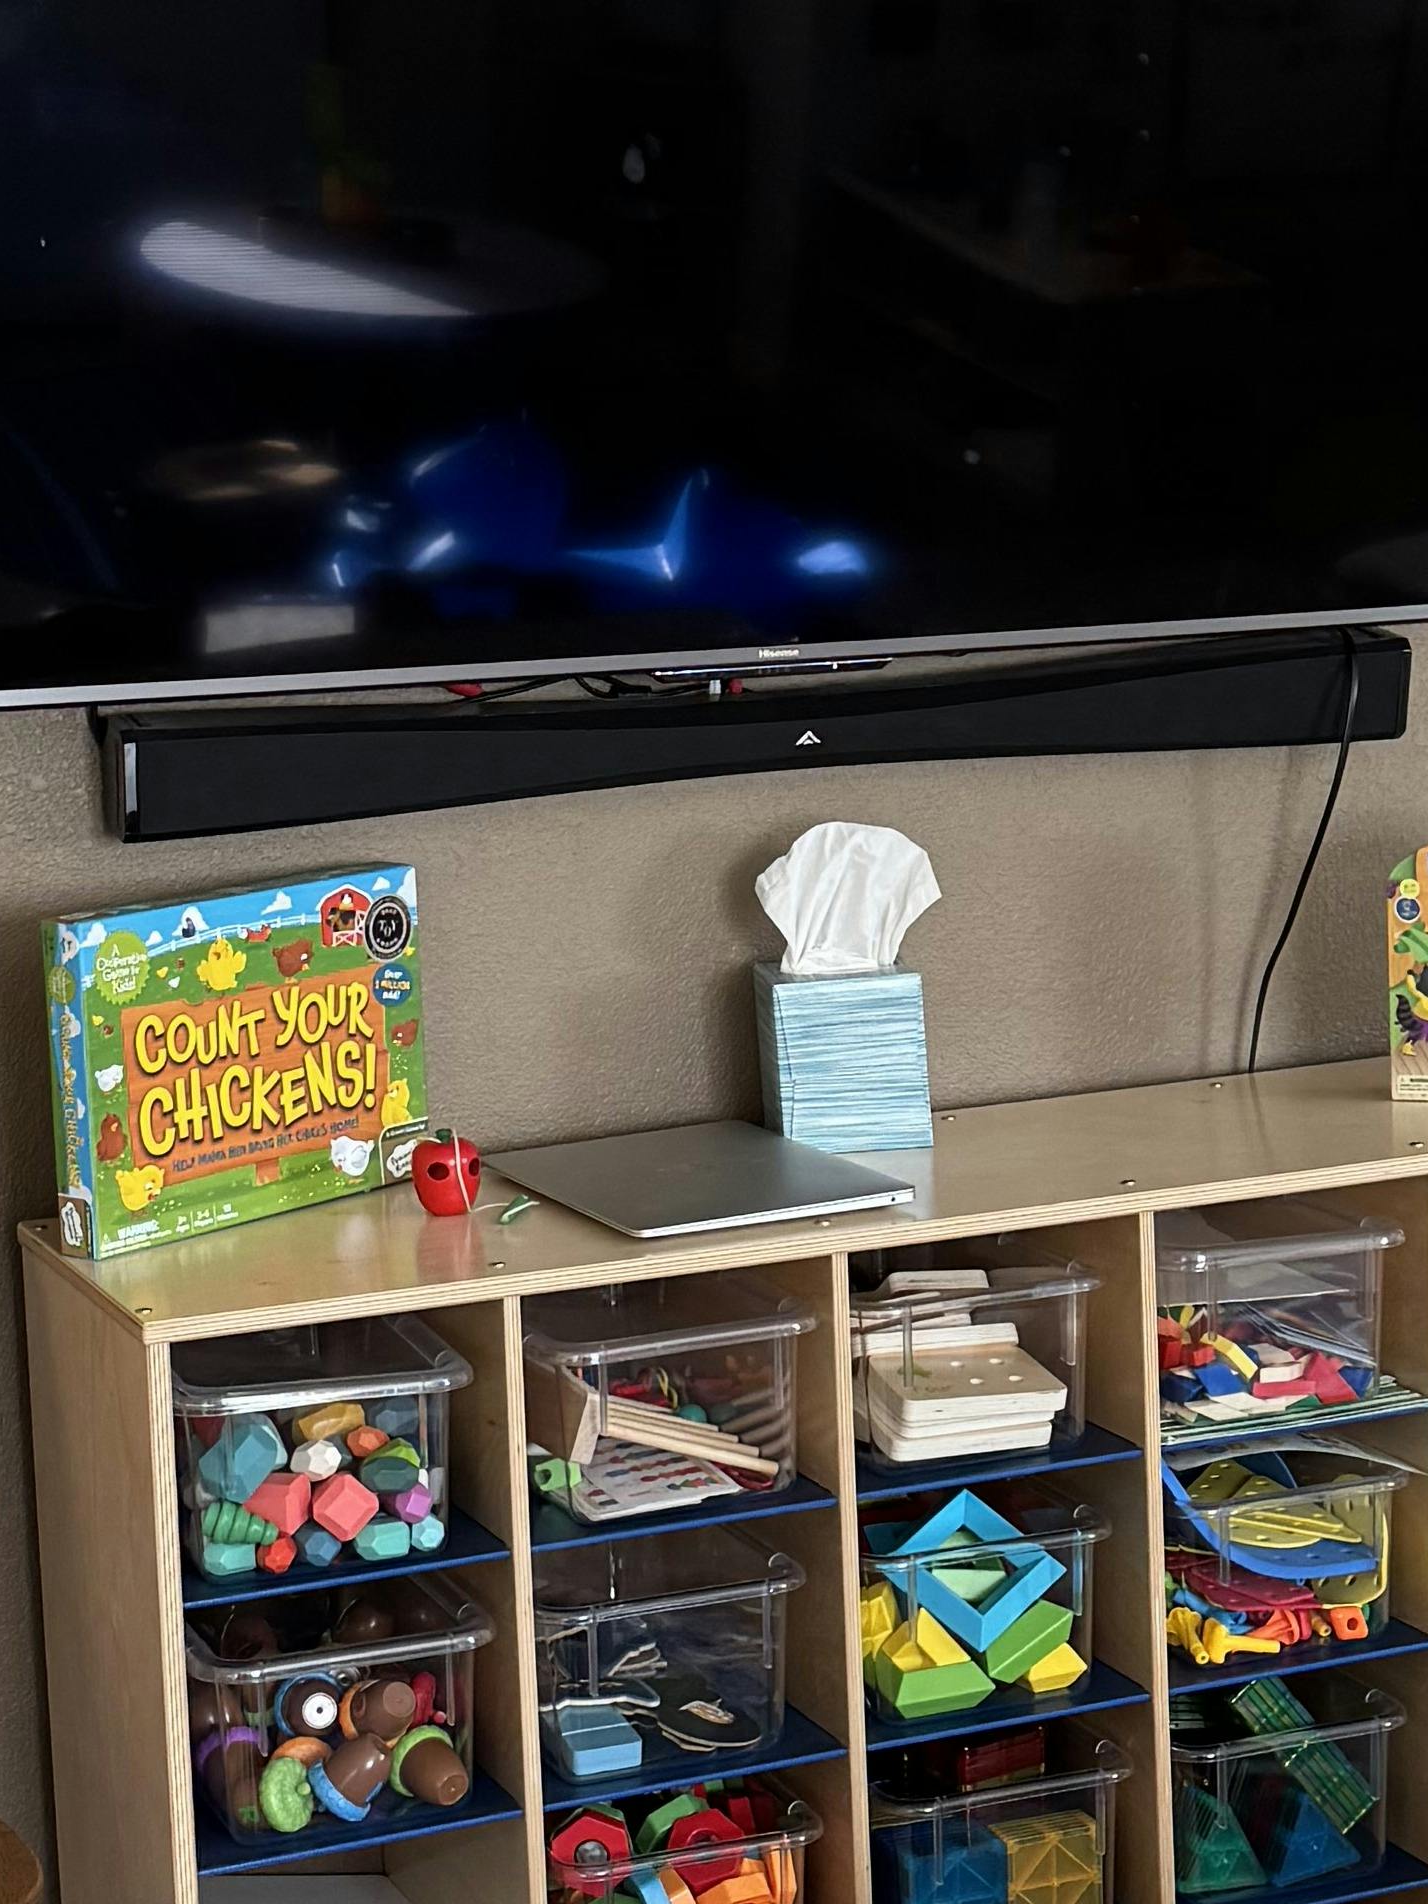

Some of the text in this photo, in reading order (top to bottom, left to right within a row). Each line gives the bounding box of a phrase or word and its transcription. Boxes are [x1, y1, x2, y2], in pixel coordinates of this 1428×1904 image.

[759, 648, 799, 659] Hisense
[378, 920, 399, 937] TOY
[111, 943, 120, 956] A
[135, 981, 373, 1074] COUNT YOUR
[137, 1040, 377, 1157] CHICKENS!
